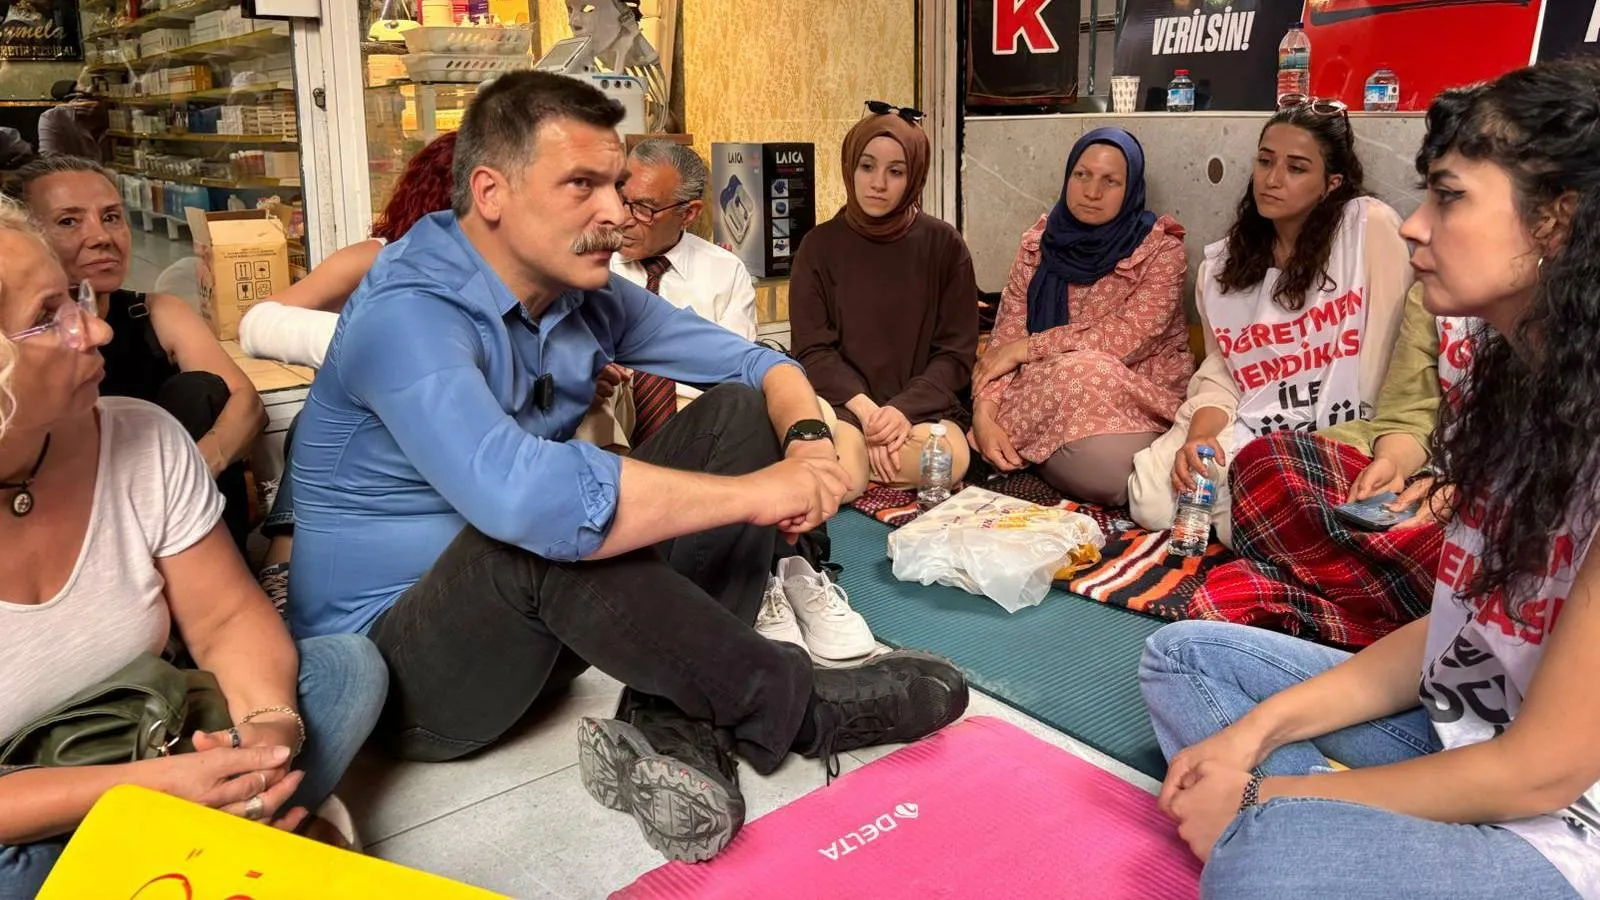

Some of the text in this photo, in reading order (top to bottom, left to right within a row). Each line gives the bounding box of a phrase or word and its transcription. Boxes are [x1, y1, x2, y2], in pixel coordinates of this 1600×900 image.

[0, 18, 67, 44] ymela
[992, 0, 1060, 55] K
[1152, 5, 1256, 55] VERİLSİN!
[727, 151, 743, 164] LAICA
[776, 151, 805, 164] LAICA
[1215, 287, 1364, 360] ÖĞRETMEN
[1233, 328, 1360, 393] SENDİKAS
[1278, 380, 1322, 410] İLE
[817, 813, 898, 861] DELTA
